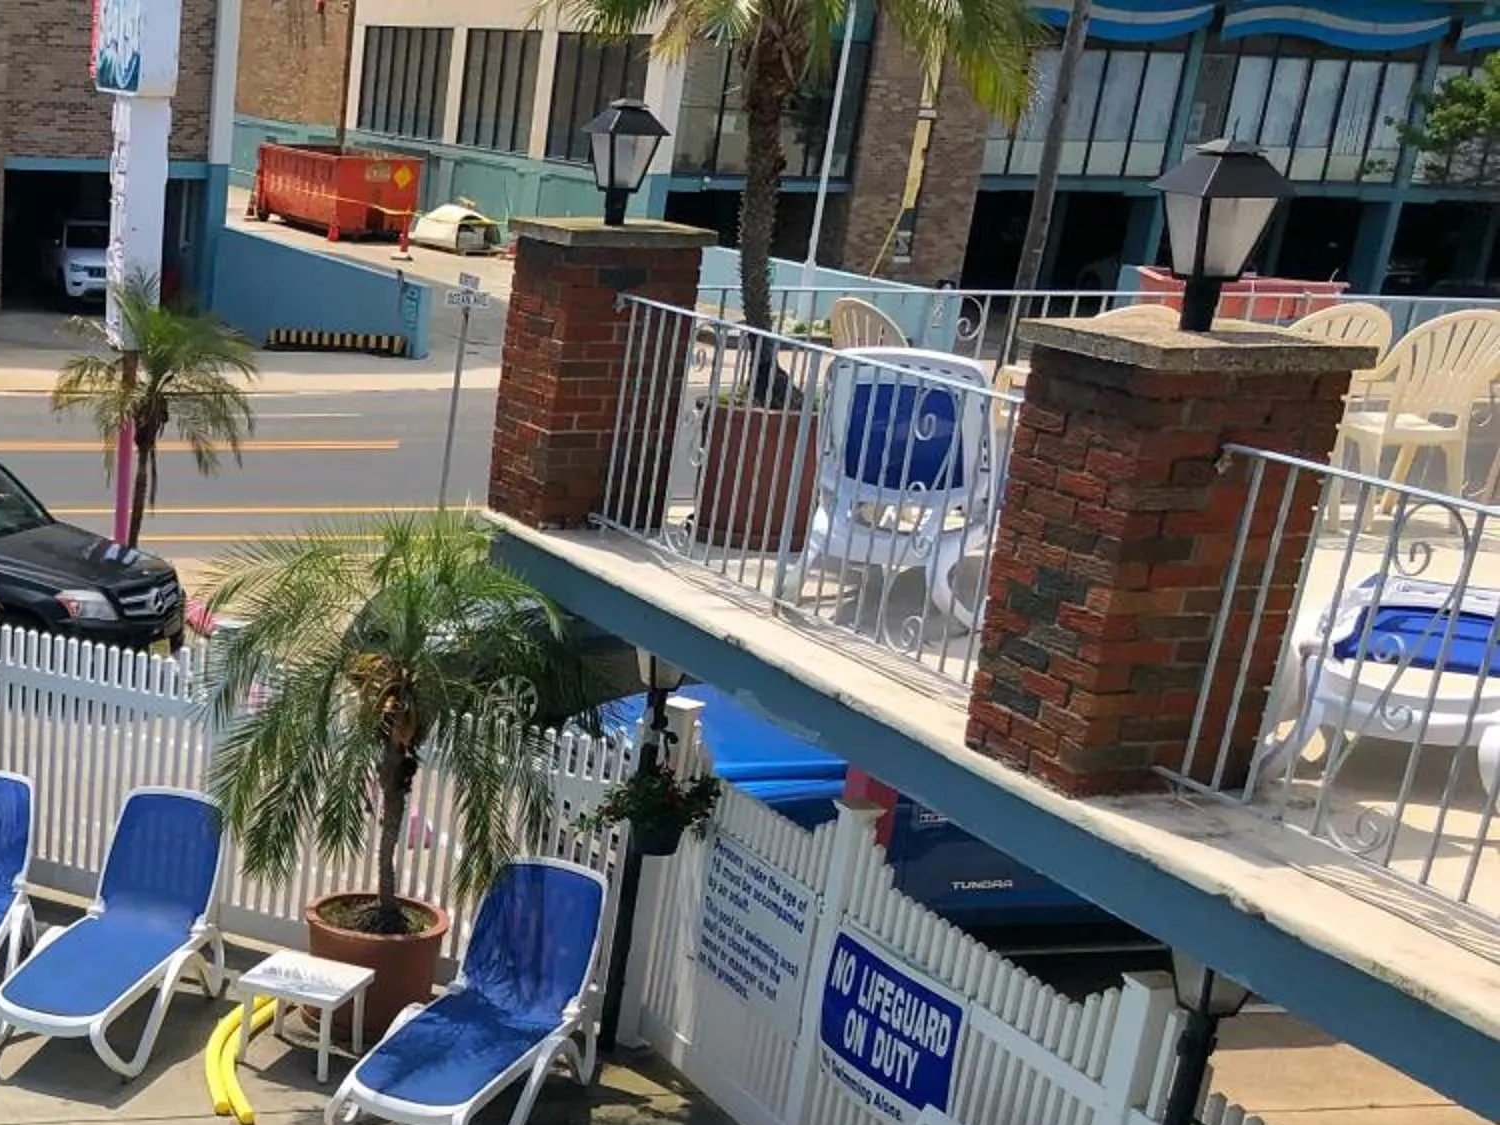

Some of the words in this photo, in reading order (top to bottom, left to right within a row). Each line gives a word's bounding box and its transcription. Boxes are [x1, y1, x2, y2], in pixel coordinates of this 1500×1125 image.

[708, 872, 717, 893] by
[718, 883, 728, 897] an
[722, 867, 741, 888] must
[742, 877, 752, 895] be
[753, 888, 805, 934] accompanied
[745, 861, 767, 884] under
[768, 876, 781, 895] the
[782, 888, 797, 908] age
[798, 900, 808, 914] of
[950, 879, 1013, 891] TUNDRA
[831, 947, 857, 997] NO
[857, 965, 952, 1058] LIFEGUARD
[843, 1008, 869, 1058] ON
[870, 1026, 920, 1090] DUTY
